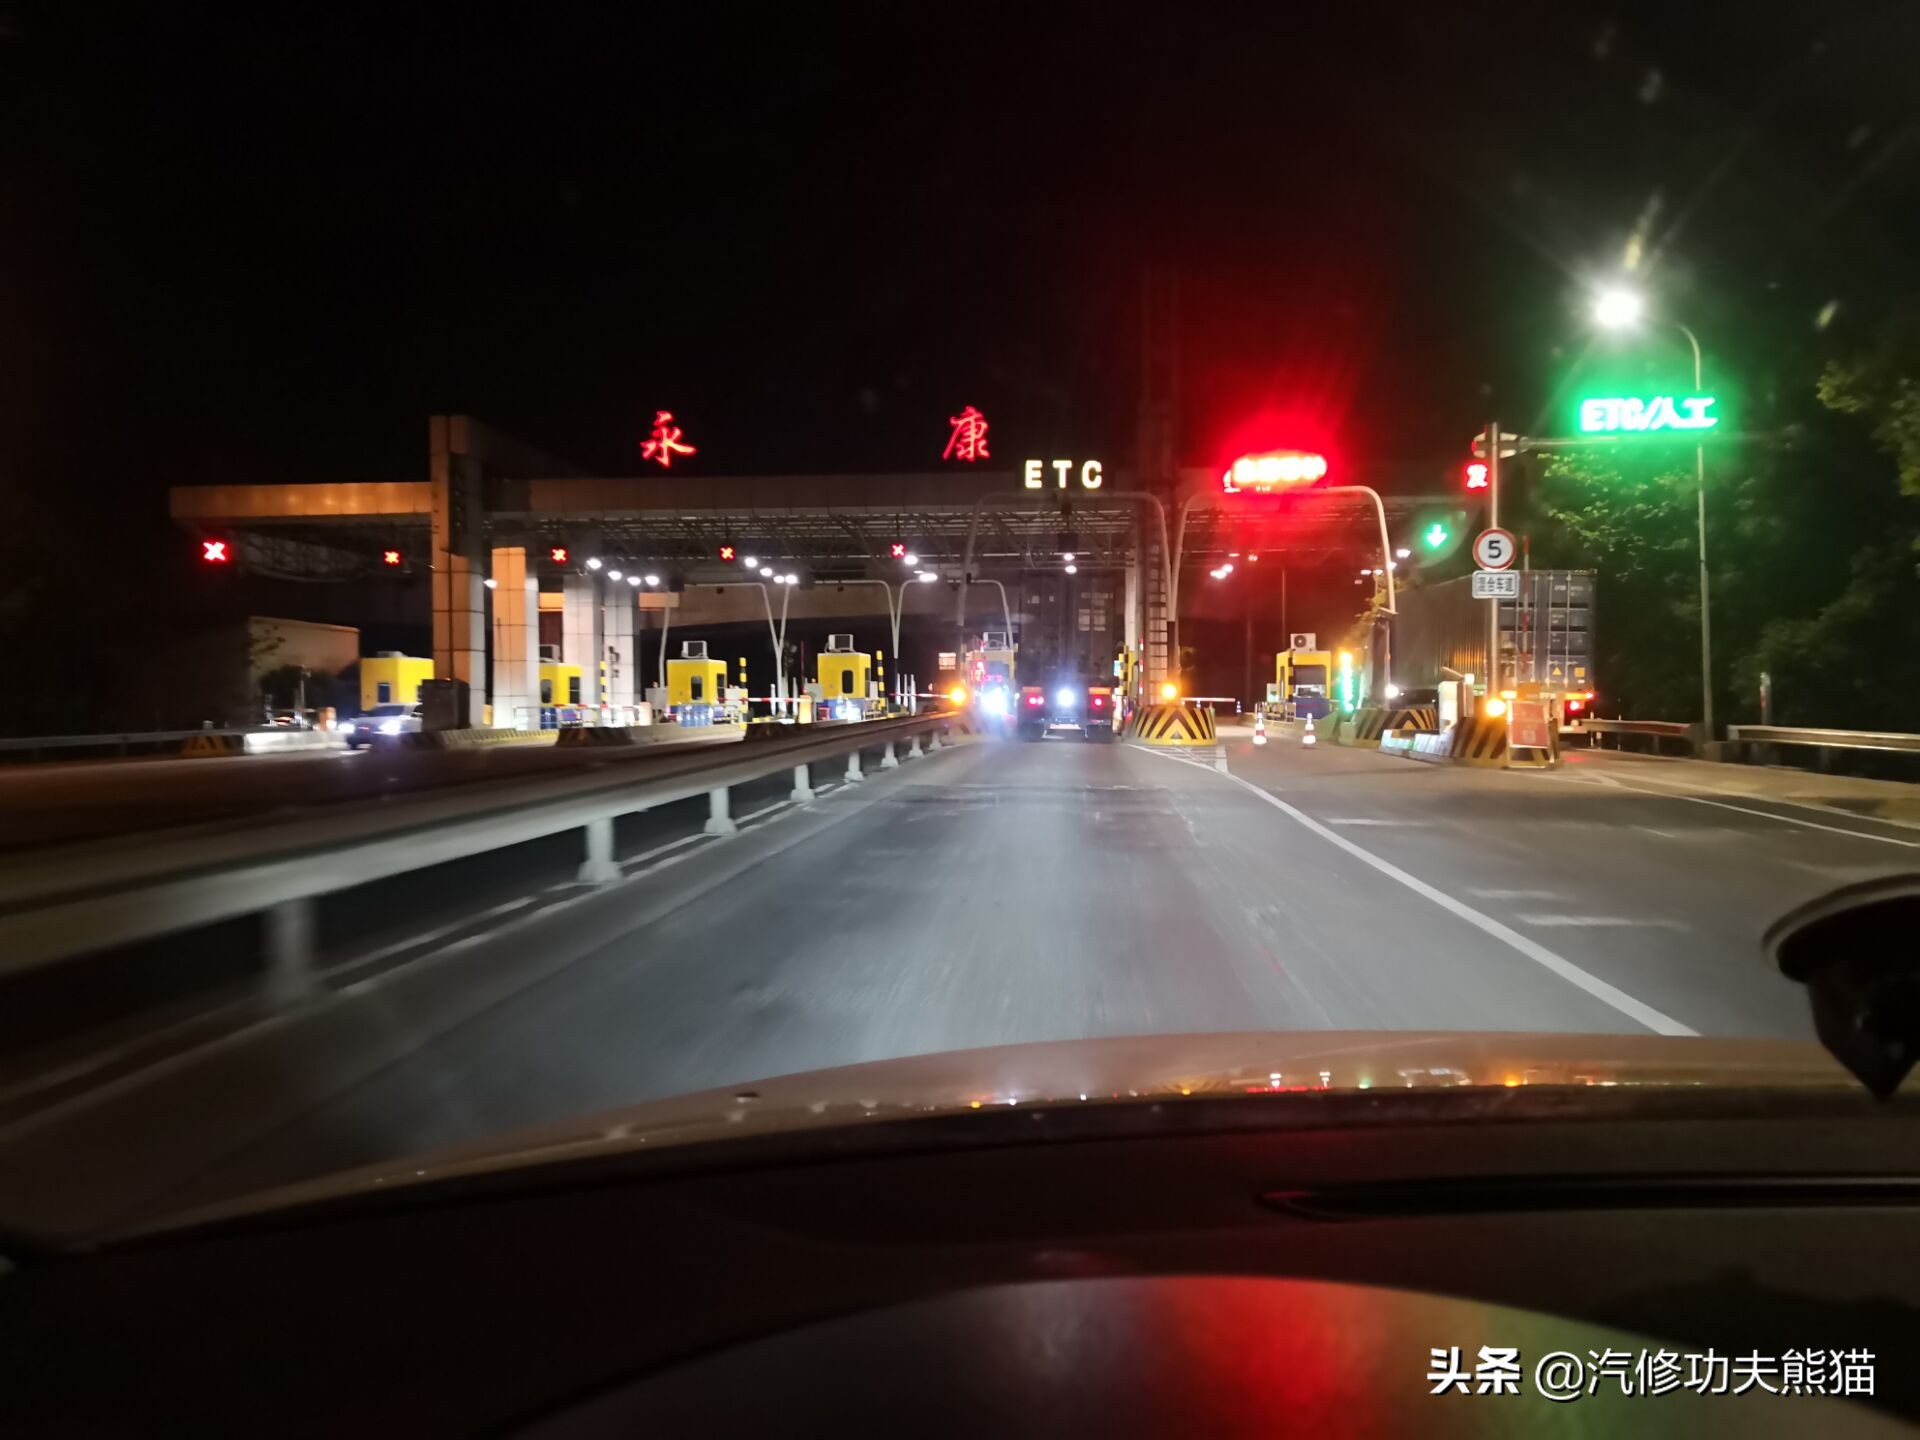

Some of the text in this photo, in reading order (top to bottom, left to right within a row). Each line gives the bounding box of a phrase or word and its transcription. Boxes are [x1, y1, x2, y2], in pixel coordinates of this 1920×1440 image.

[640, 406, 991, 468] 永 康
[1024, 459, 1103, 489] ETC
[1488, 540, 1502, 559] 5
